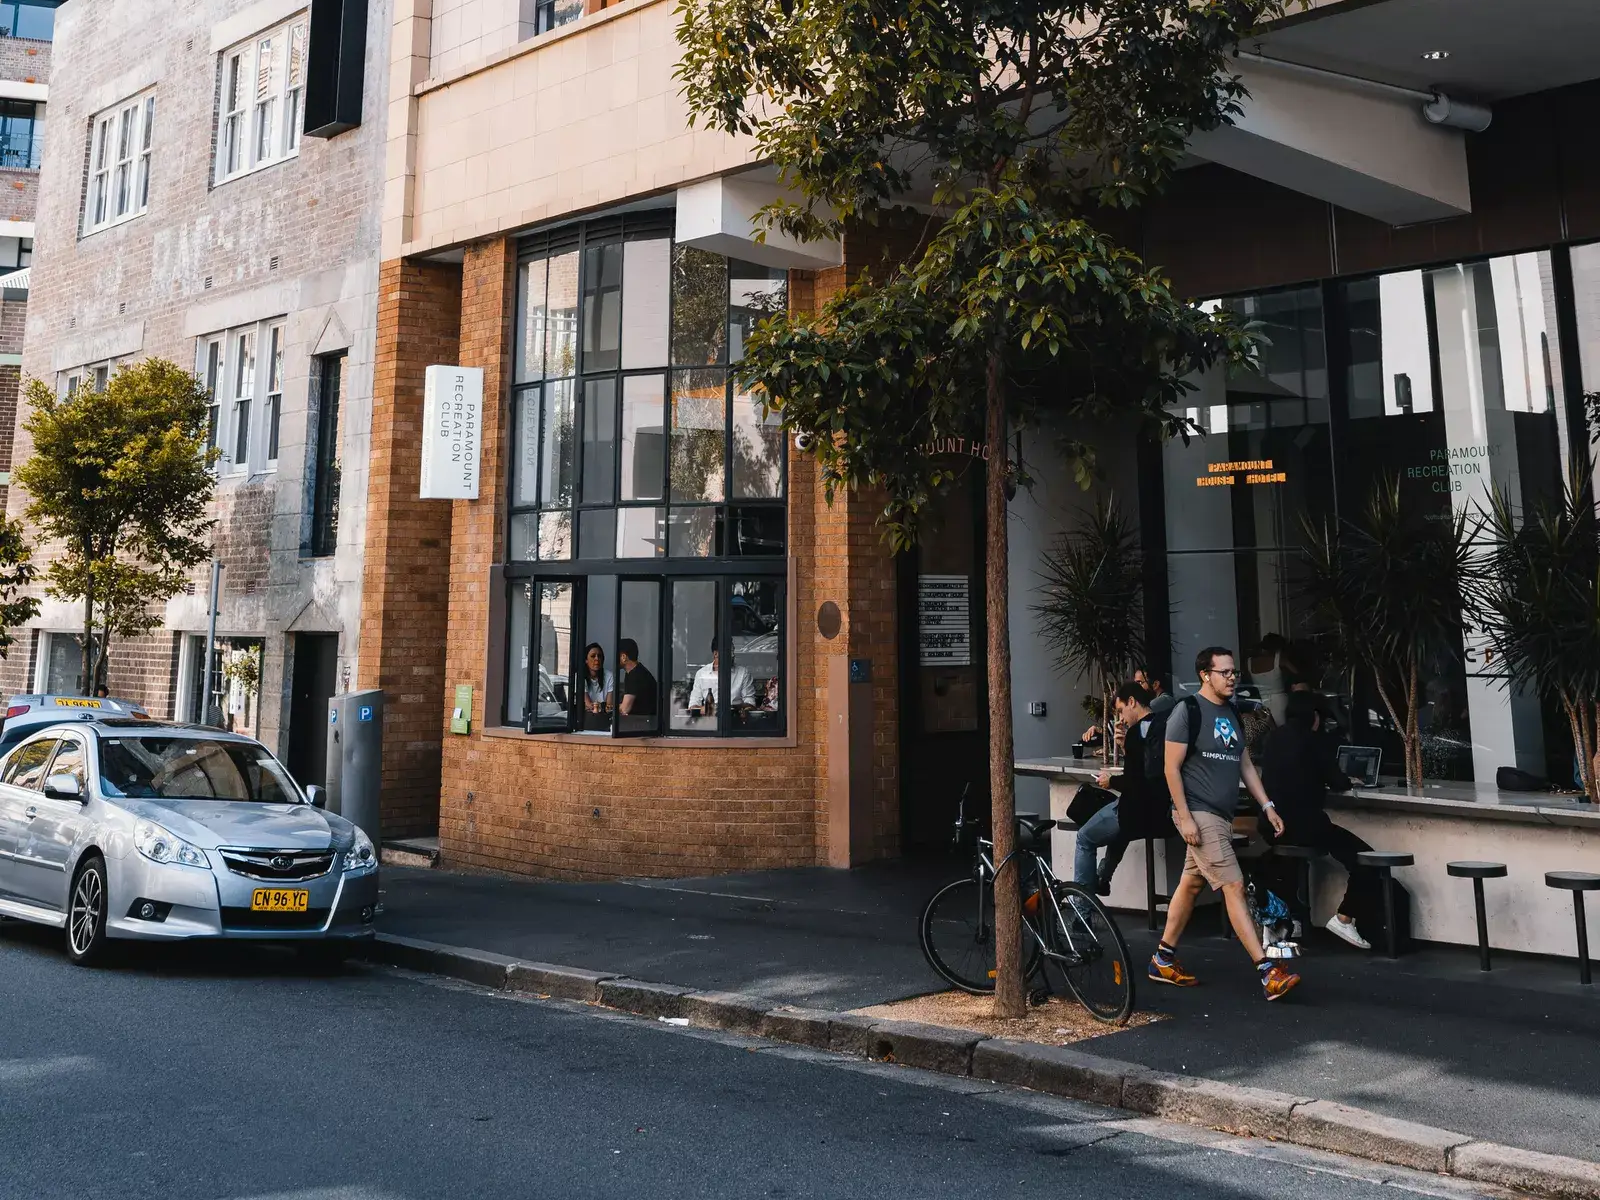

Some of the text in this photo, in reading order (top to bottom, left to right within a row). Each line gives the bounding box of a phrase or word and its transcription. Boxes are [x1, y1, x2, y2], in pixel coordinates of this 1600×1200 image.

[440, 402, 451, 437] CLUB
[452, 376, 464, 462] RECREATION
[463, 404, 475, 490] PARAMOUNT
[1430, 445, 1501, 460] PARAMOUNT
[1210, 460, 1268, 472] PARAMOUNT
[1408, 463, 1481, 478] RECREATION
[1199, 473, 1282, 486] HOUSE HOTEL
[1432, 481, 1462, 493] CLUB
[361, 707, 370, 720] P
